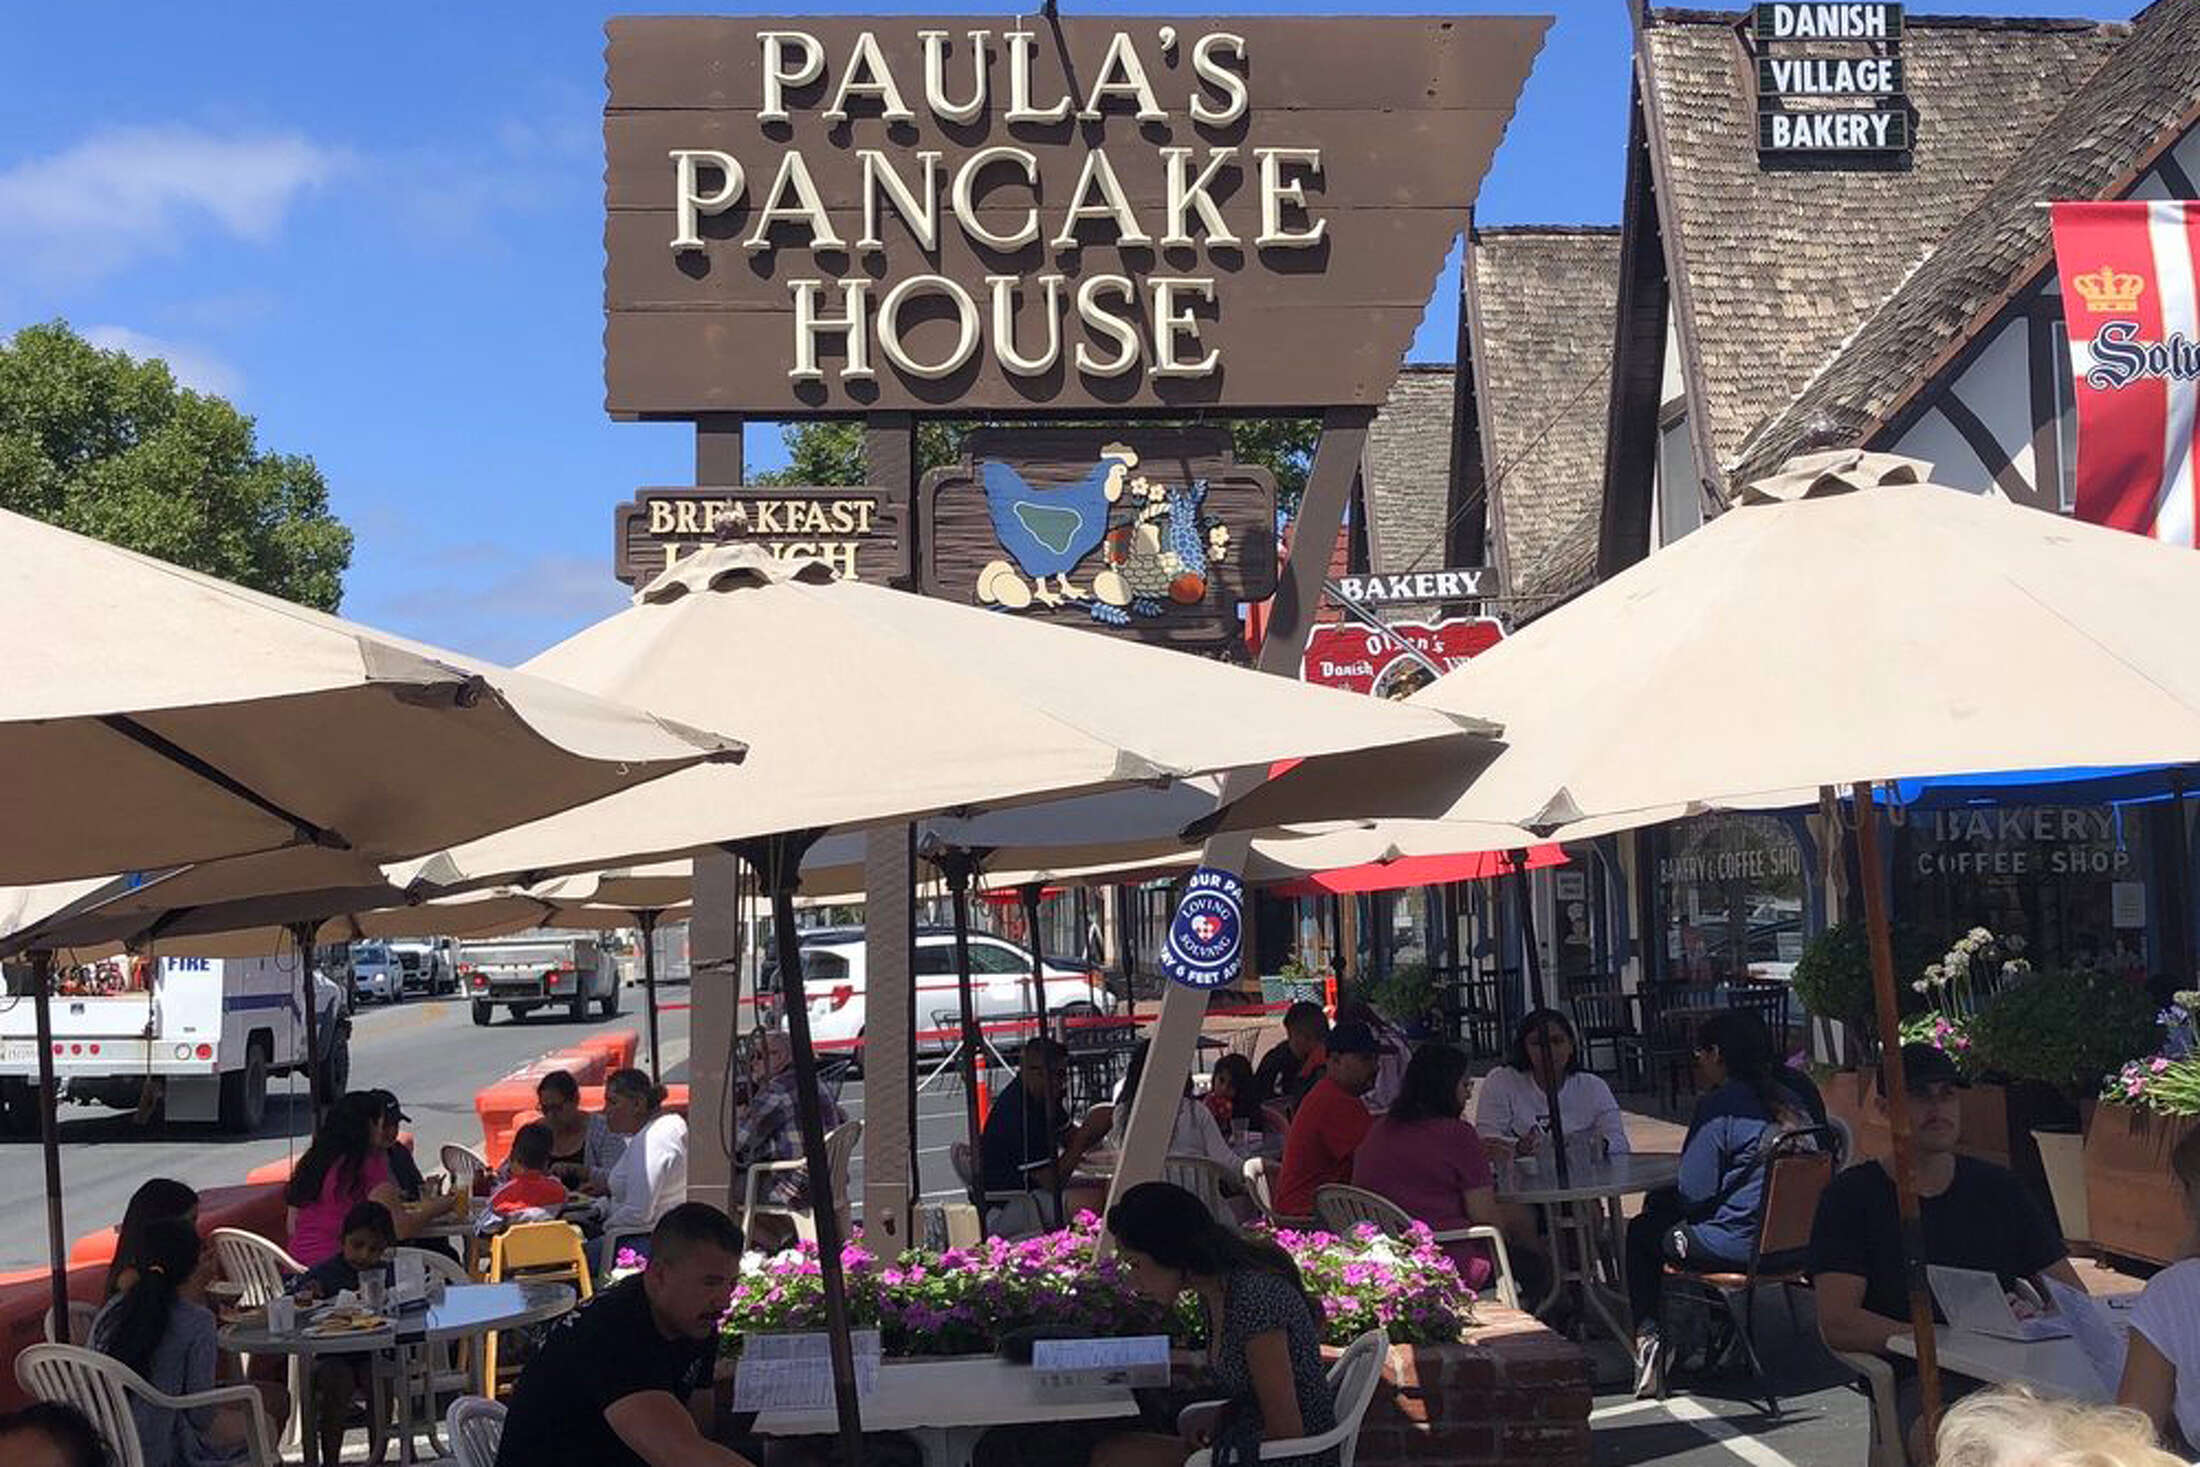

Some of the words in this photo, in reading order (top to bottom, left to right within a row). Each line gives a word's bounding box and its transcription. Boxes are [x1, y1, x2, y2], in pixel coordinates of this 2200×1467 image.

[1774, 4, 1887, 37] DANISH
[756, 27, 1250, 127] PAULA'S
[1771, 59, 1894, 93] VILLAGE
[1772, 113, 1891, 148] BAKERY
[668, 146, 1328, 253] PANCAKE
[787, 273, 1221, 380] HOUSE
[1340, 571, 1482, 601] BAKERY
[1320, 661, 1375, 677] Danish
[1935, 808, 2115, 842] BAKERY
[1718, 849, 1765, 880] COFFEE
[1918, 851, 2028, 875] COFFEE
[2051, 850, 2130, 874] SHOP
[1182, 899, 1231, 919] LOVING
[1181, 934, 1231, 957] SOLVANG
[168, 956, 210, 971] FIRE
[1187, 970, 1220, 984] FEET
